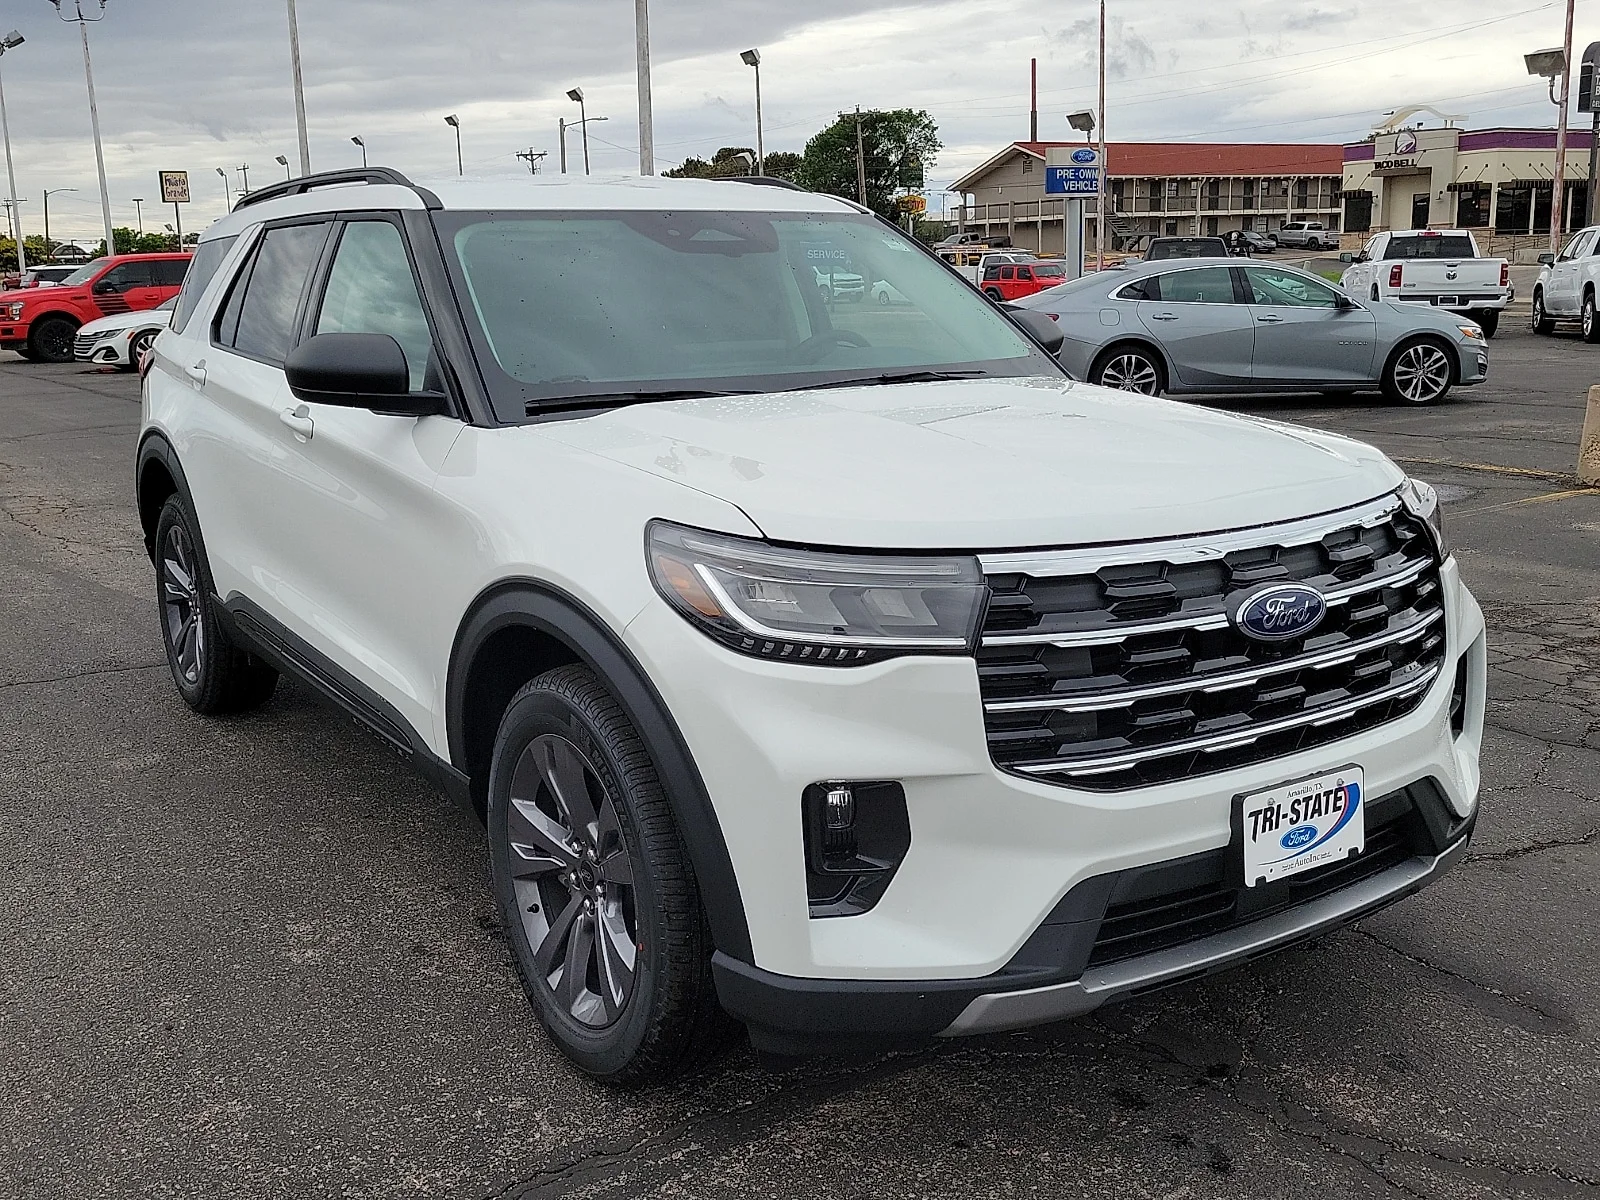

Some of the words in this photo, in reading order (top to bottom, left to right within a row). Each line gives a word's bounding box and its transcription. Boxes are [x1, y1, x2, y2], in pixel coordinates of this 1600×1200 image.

[1394, 159, 1417, 168] BELL
[1056, 169, 1105, 180] PRE-OWN
[807, 249, 845, 259] SERVICE
[1263, 596, 1310, 630] Ford
[1314, 782, 1324, 791] TX
[1248, 787, 1345, 844] TRI-STATE
[1288, 828, 1311, 846] Ford
